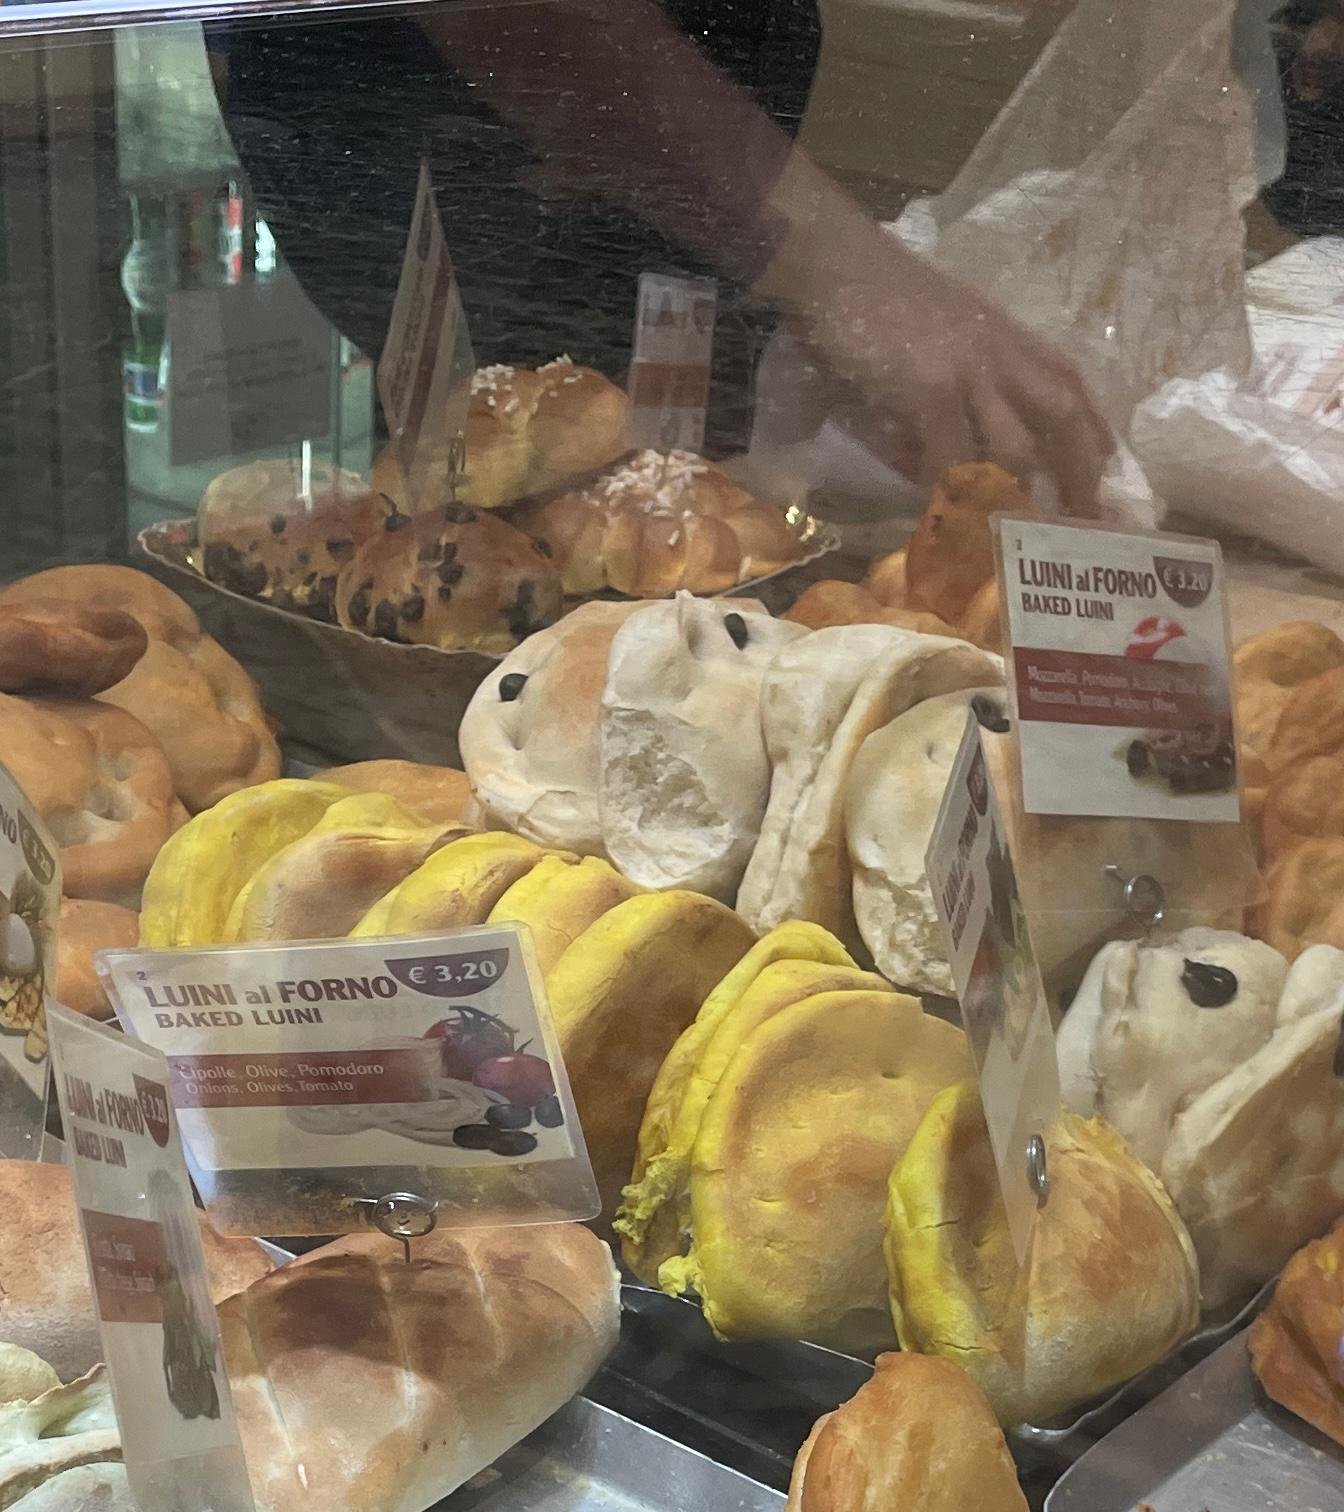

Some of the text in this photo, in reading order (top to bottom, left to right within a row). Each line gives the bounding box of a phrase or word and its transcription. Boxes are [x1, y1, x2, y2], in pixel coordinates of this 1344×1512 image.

[1018, 558, 1157, 599] LUINI al FORNO
[1021, 592, 1115, 621] BAKED LUINI
[136, 970, 147, 981] 2
[408, 959, 498, 985] € 3,20
[142, 974, 398, 1009] LUINI al FORNO
[154, 1006, 324, 1029] BAKED LUINI
[297, 1063, 385, 1078] Pomodoro
